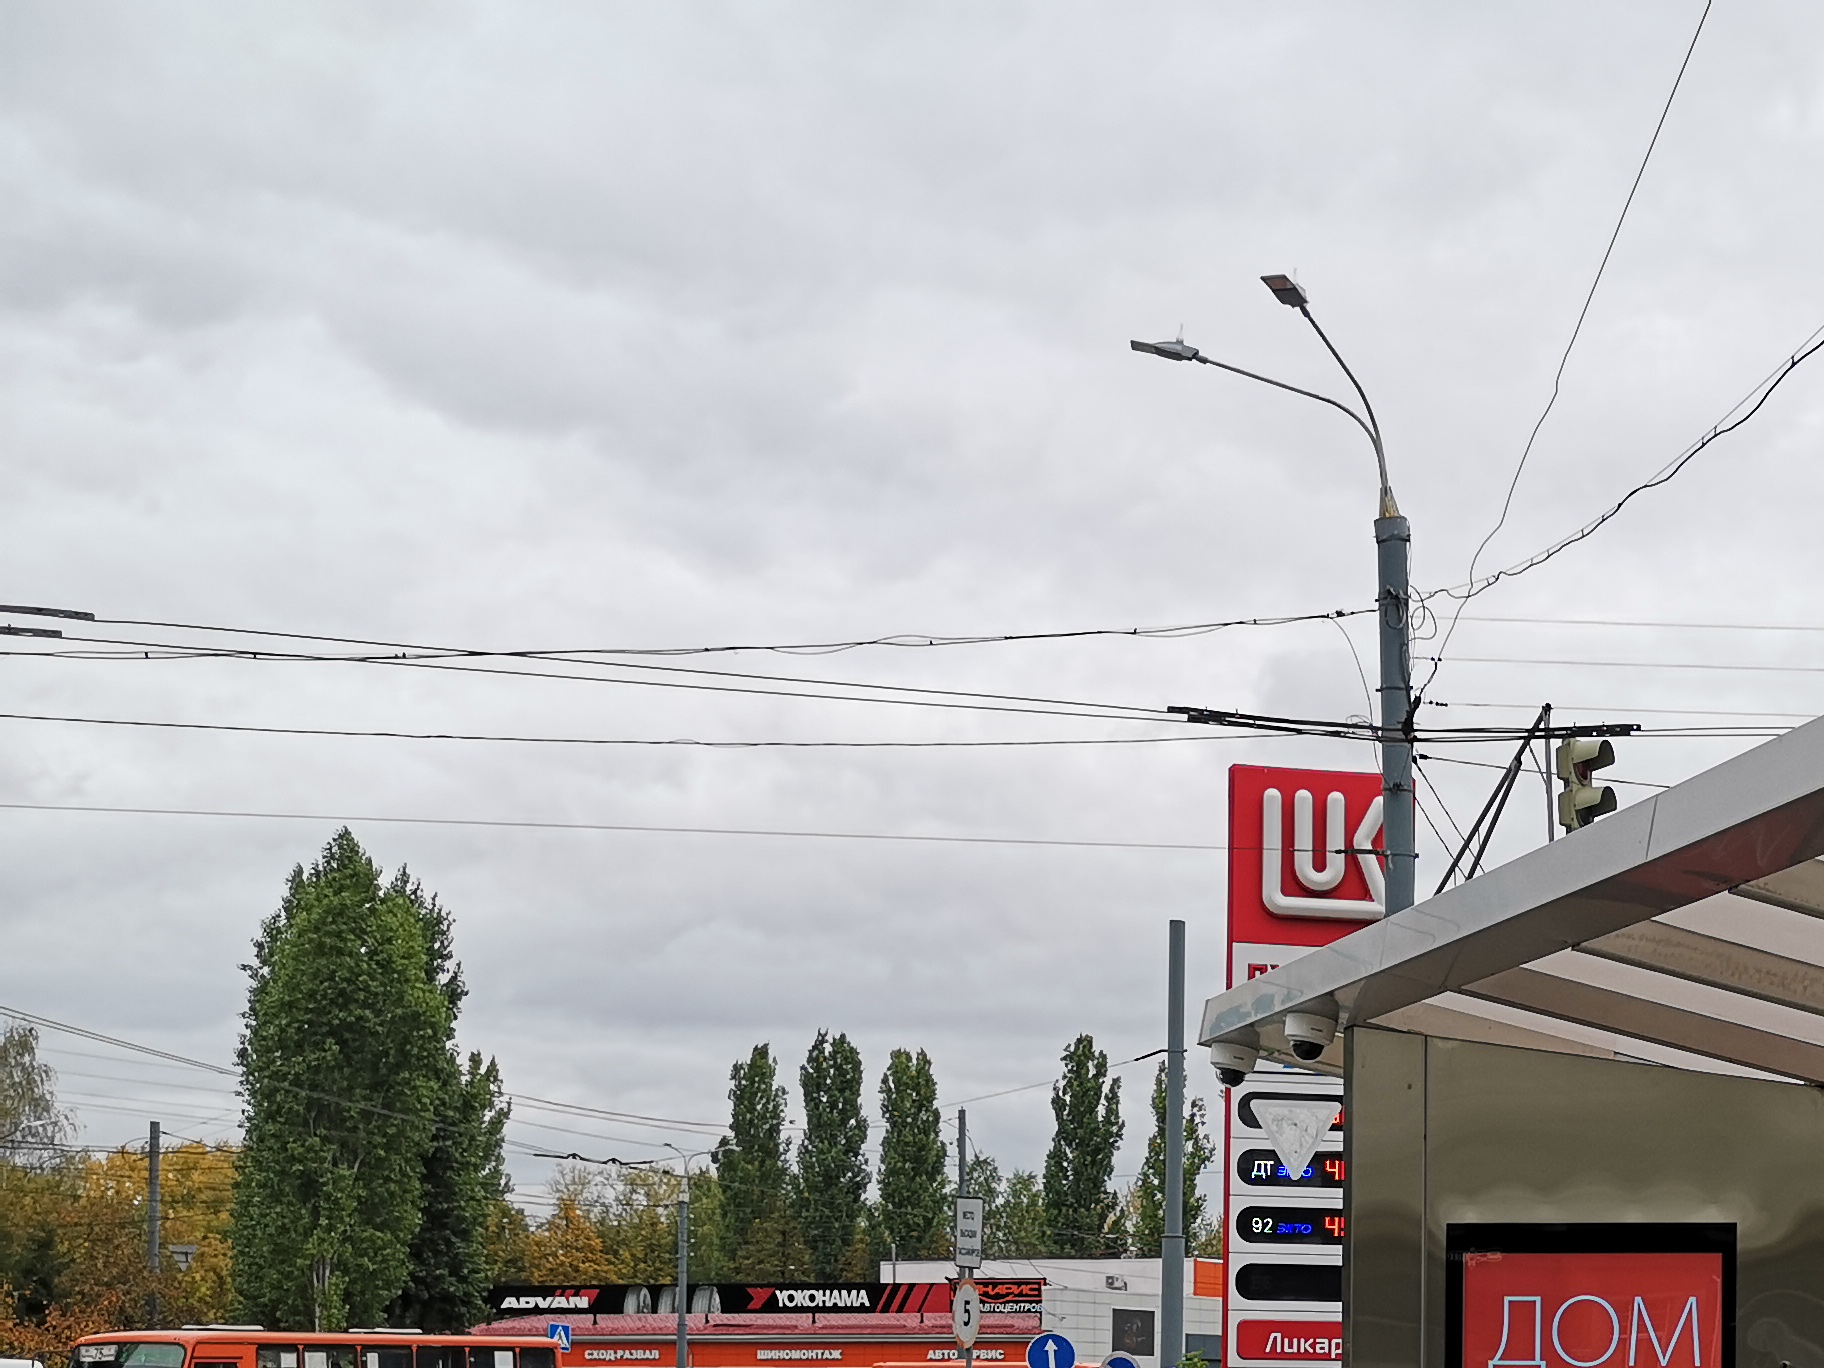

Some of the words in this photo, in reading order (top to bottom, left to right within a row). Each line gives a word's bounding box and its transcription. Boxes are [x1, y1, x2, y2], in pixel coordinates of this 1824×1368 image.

[1251, 1160, 1275, 1179] ДТ
[1251, 1217, 1273, 1233] 92
[500, 1296, 589, 1309] ADVAN
[774, 1289, 870, 1308] YOKOHAMA
[963, 1299, 971, 1327] 5
[584, 1350, 660, 1361] СХОД-РАЗВАЛ
[757, 1349, 842, 1360] ШИНОМОНТАЖ
[927, 1350, 1005, 1360] АВТОРВИС
